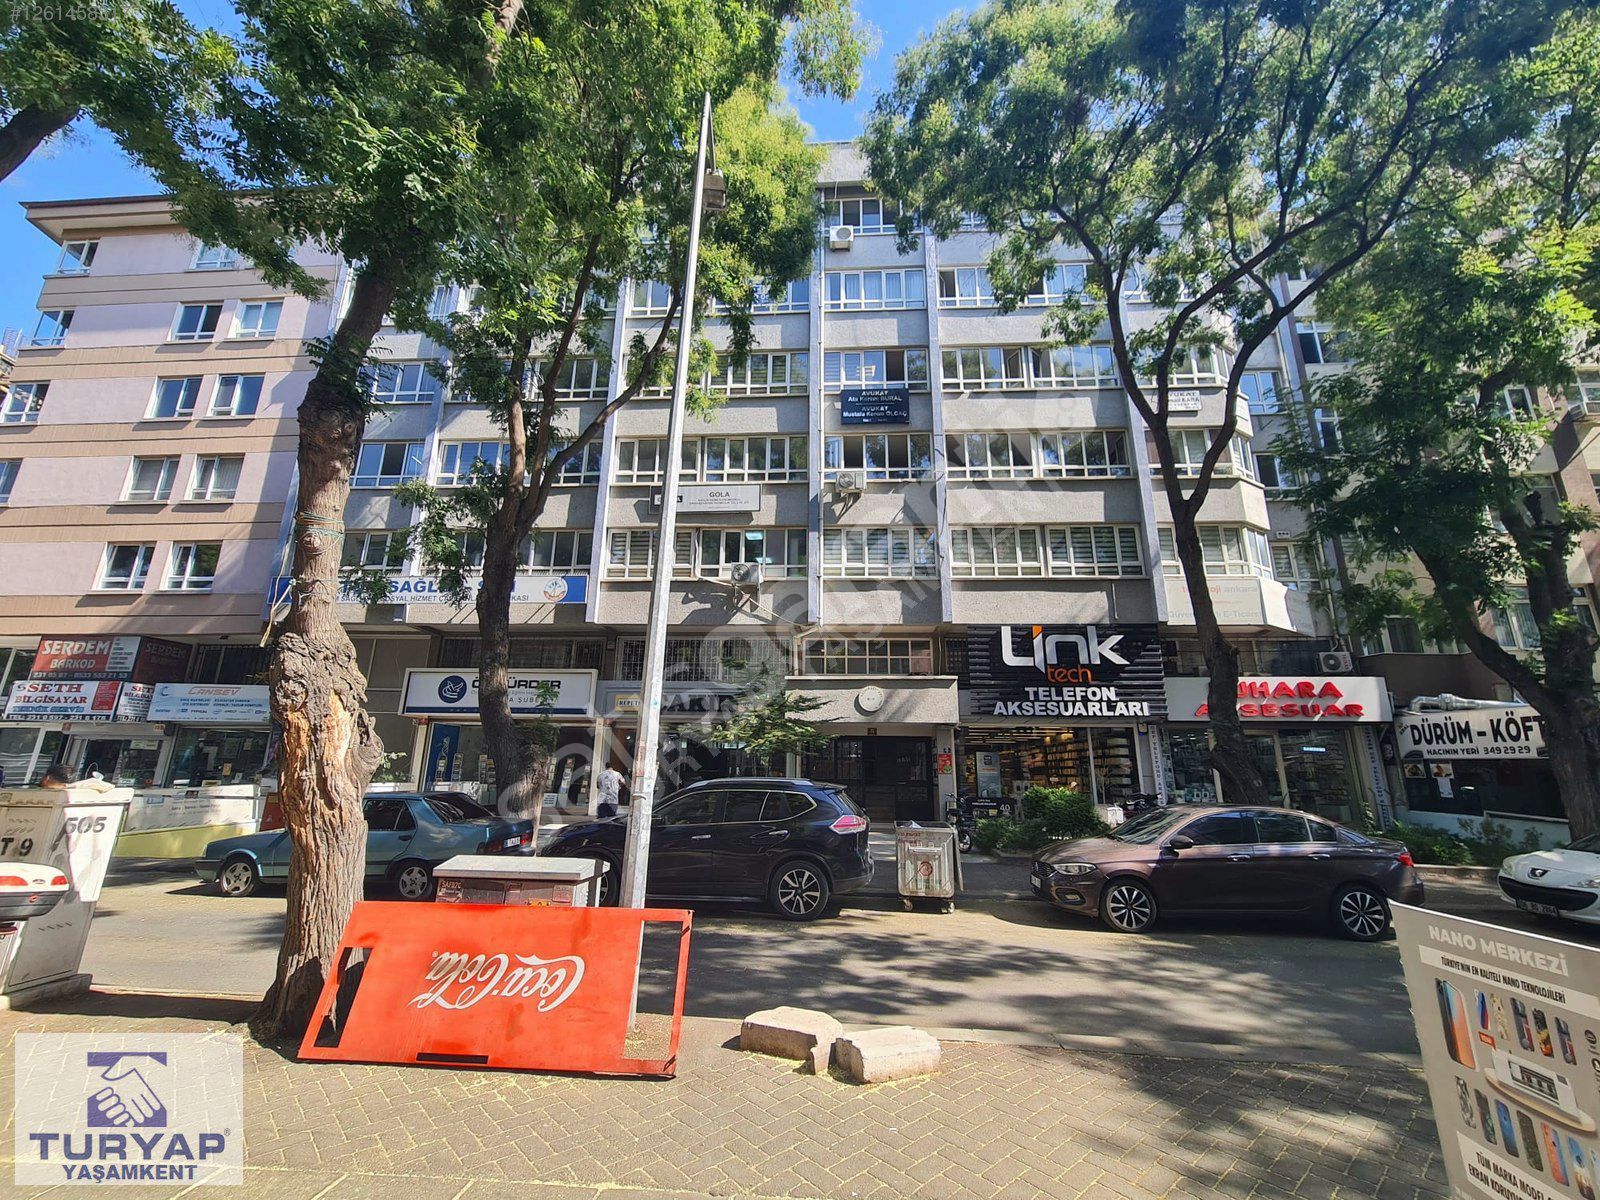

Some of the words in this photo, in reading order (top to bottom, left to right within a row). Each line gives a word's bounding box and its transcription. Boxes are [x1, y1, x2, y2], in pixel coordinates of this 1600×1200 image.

[42, 640, 111, 656] SERDEM
[50, 659, 95, 669] BARKOD
[1047, 665, 1092, 683] tech
[28, 684, 83, 693] SETH
[472, 676, 561, 689] ÖÜRDER
[1237, 681, 1344, 698] UHARA
[14, 695, 87, 704] BİLGİSAYAR
[1025, 687, 1119, 701] TELEFON
[993, 702, 1150, 716] AKSESUARLARI
[1195, 703, 1365, 717] ASESUAR
[1410, 718, 1473, 746] DÜRÜM
[1490, 711, 1545, 744] KÖFT
[1461, 746, 1479, 755] YERİ
[66, 817, 107, 834] 505
[1428, 925, 1477, 951] NANO
[1479, 938, 1569, 976] MERKEZİ
[1468, 1163, 1490, 1187] EKRAN
[1492, 1162, 1518, 1187] MARKA
